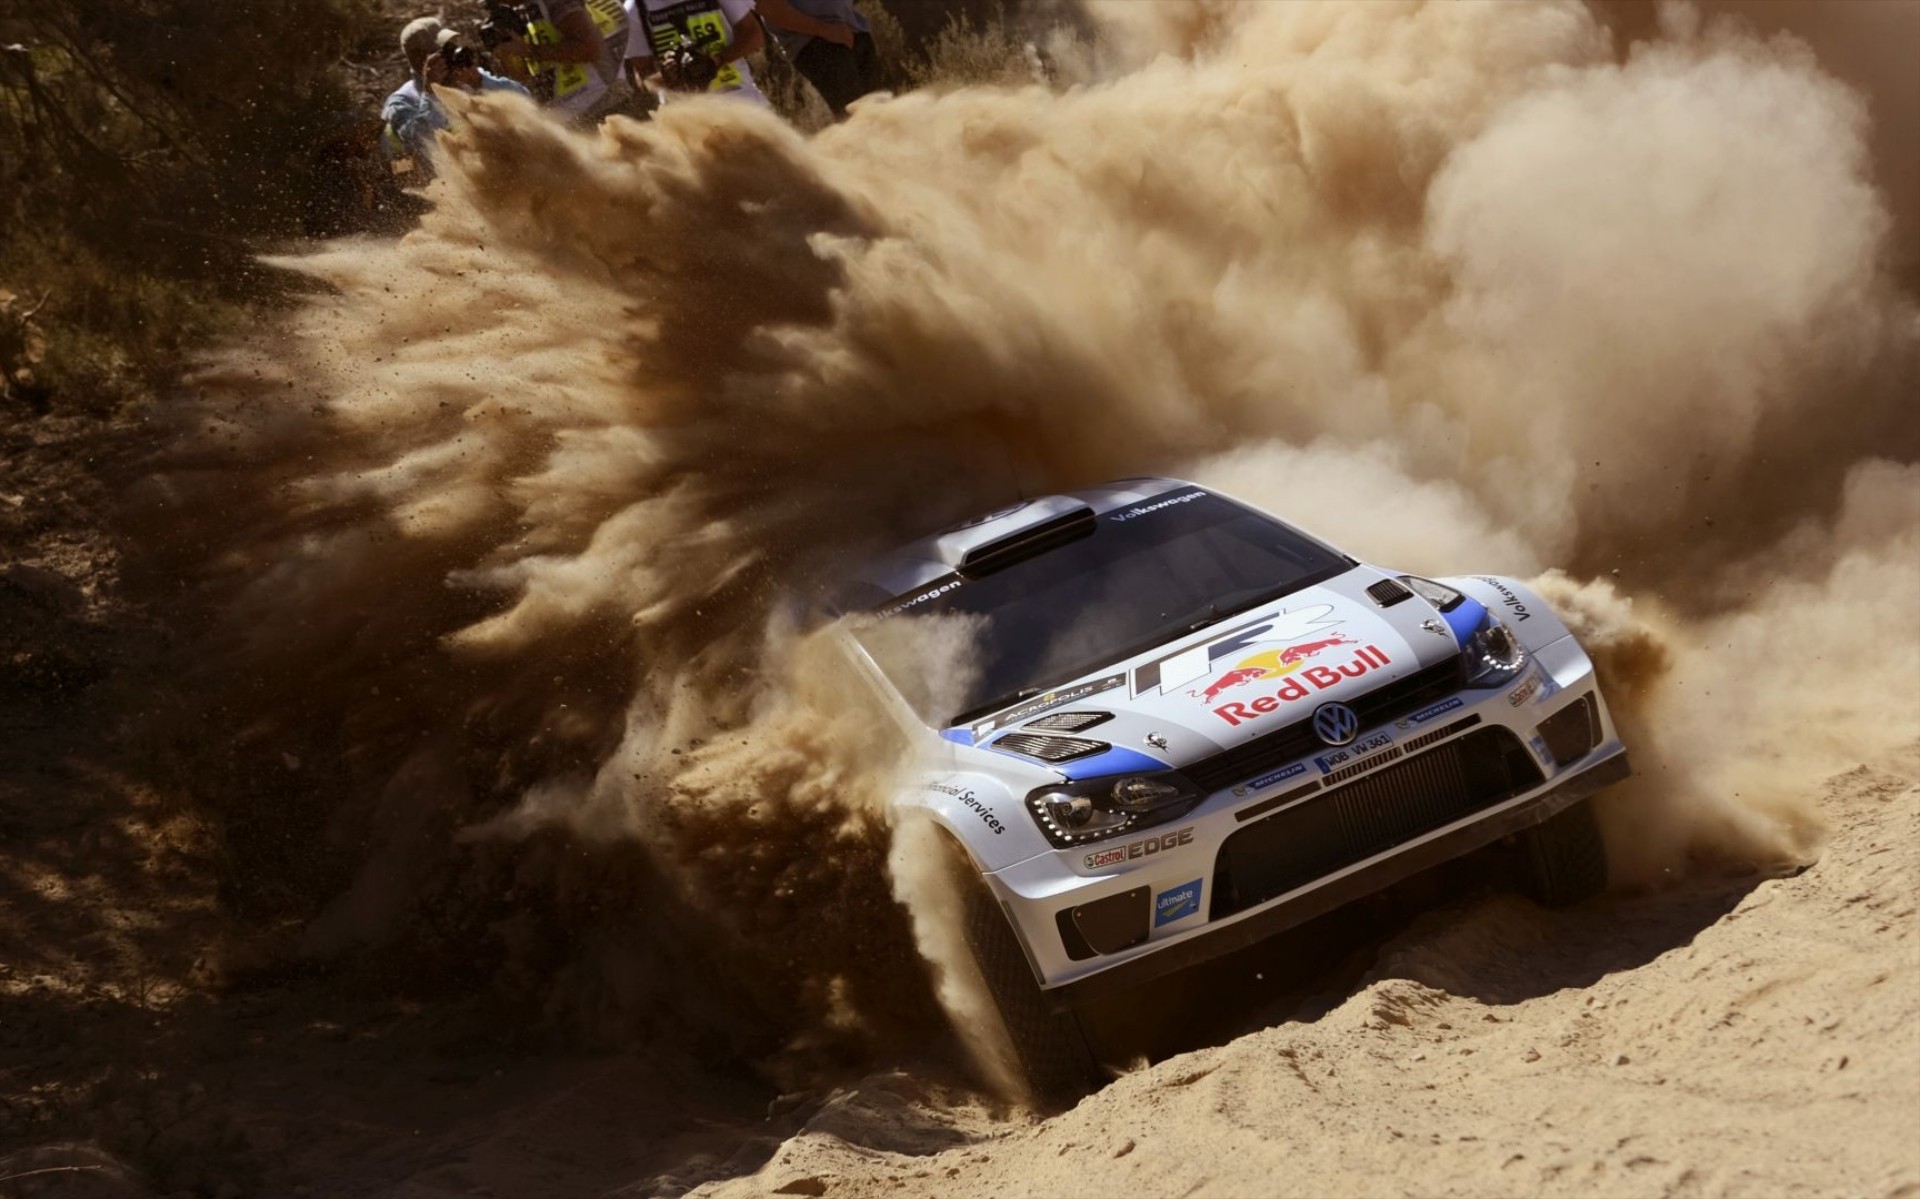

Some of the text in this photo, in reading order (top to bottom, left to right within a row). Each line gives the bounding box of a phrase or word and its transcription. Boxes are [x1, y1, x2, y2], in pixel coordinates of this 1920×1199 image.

[1110, 491, 1207, 522] Volkswagen
[876, 580, 962, 619] lkswagen
[1213, 645, 1392, 727] Red Bull
[1416, 700, 1459, 720] MICHELIN
[1324, 735, 1390, 766] WOB VW 361
[1254, 765, 1302, 787] MICHELIN
[958, 790, 1006, 835] Services
[1094, 826, 1194, 866] Castrol EDGE
[1157, 890, 1193, 910] ultimate
